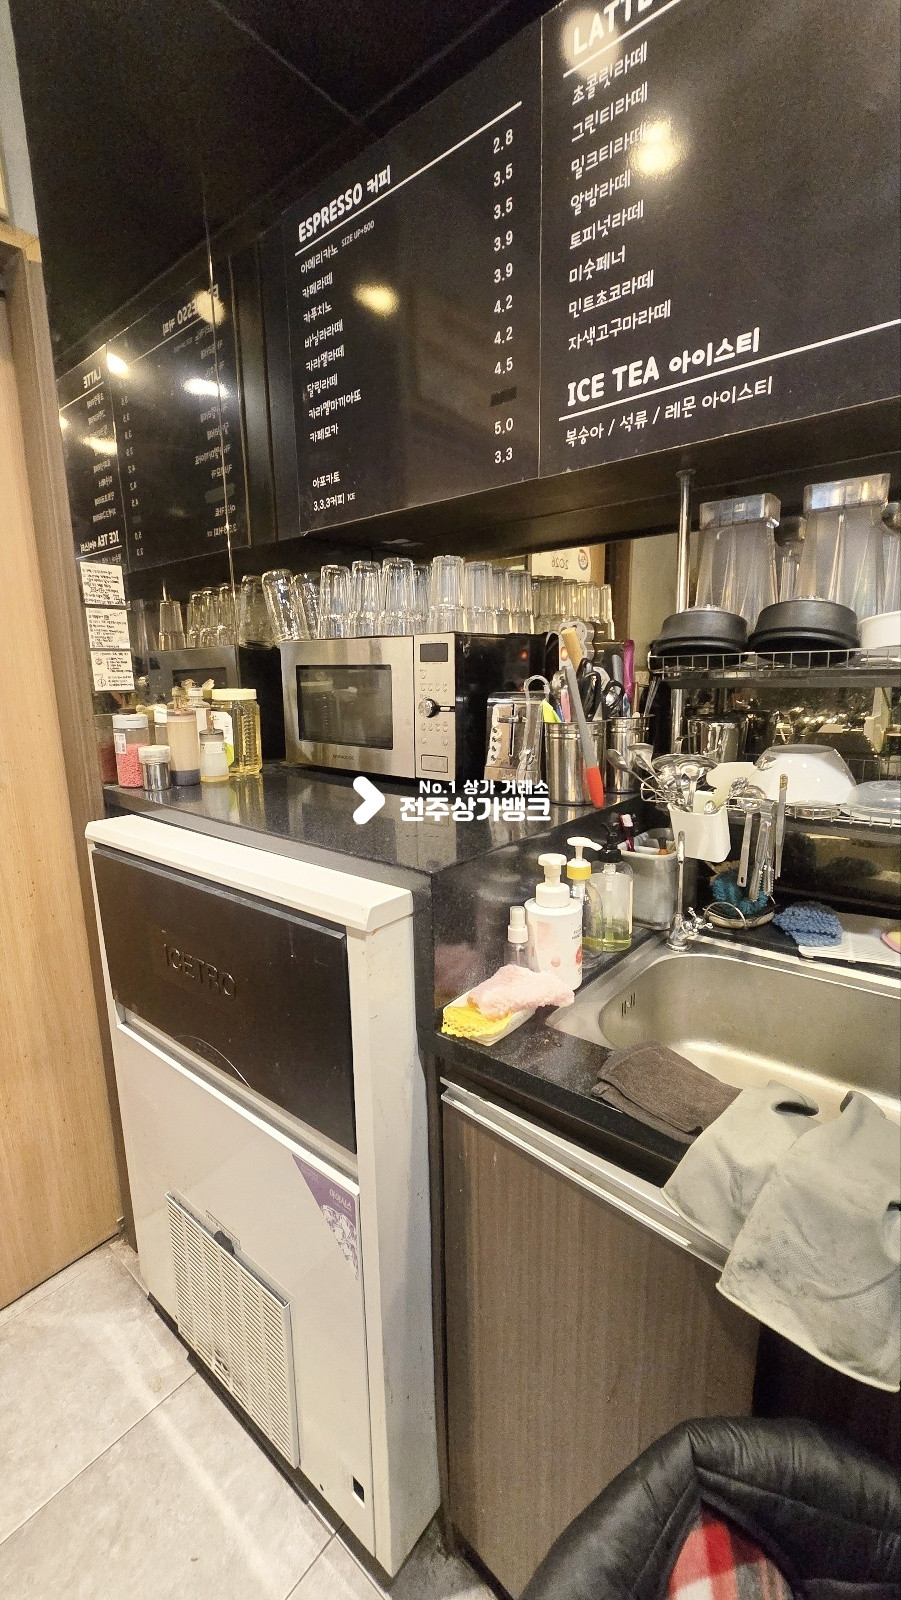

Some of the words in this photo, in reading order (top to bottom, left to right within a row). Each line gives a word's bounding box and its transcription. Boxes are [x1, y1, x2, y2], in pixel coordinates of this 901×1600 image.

[572, 41, 647, 106] 초콜릿라떼
[572, 81, 647, 142] 그린티라떼
[494, 129, 513, 153] 2.8
[571, 121, 645, 180] 밀크티라떼
[494, 163, 513, 186] 3.5
[298, 183, 363, 242] ESPRESSO
[367, 165, 391, 193] 커피
[571, 169, 630, 216] 알밤라떼
[494, 197, 513, 219] 3.5
[570, 199, 643, 249] 토피넛라떼
[300, 244, 339, 273] 아메리카노
[341, 232, 354, 247] SIZE
[494, 230, 513, 251] 3.9
[494, 263, 513, 283] 3.9
[569, 244, 626, 283] 미숫페너
[494, 295, 513, 314] 4.2
[568, 269, 655, 319] 민트초코라떼
[303, 301, 332, 323] 카푸치노
[568, 299, 671, 350] 자색고구마라떼
[304, 319, 344, 348] 바닐라라떼
[494, 326, 513, 344] 4.2
[305, 345, 345, 372] 카라멜라떼
[494, 357, 513, 374] 4.5
[567, 372, 605, 406] ICE
[612, 356, 660, 393] TEA
[668, 327, 760, 374] 아이스티
[495, 418, 514, 434] 5.0
[565, 423, 604, 448] 복숭아
[619, 409, 648, 432] 석류
[664, 395, 697, 420] 레몬
[701, 376, 773, 409] 아이스티
[309, 423, 339, 443] 카페모카
[495, 447, 513, 463] 3.3
[312, 471, 341, 489] 아포카토
[163, 943, 238, 998] ICETRO
